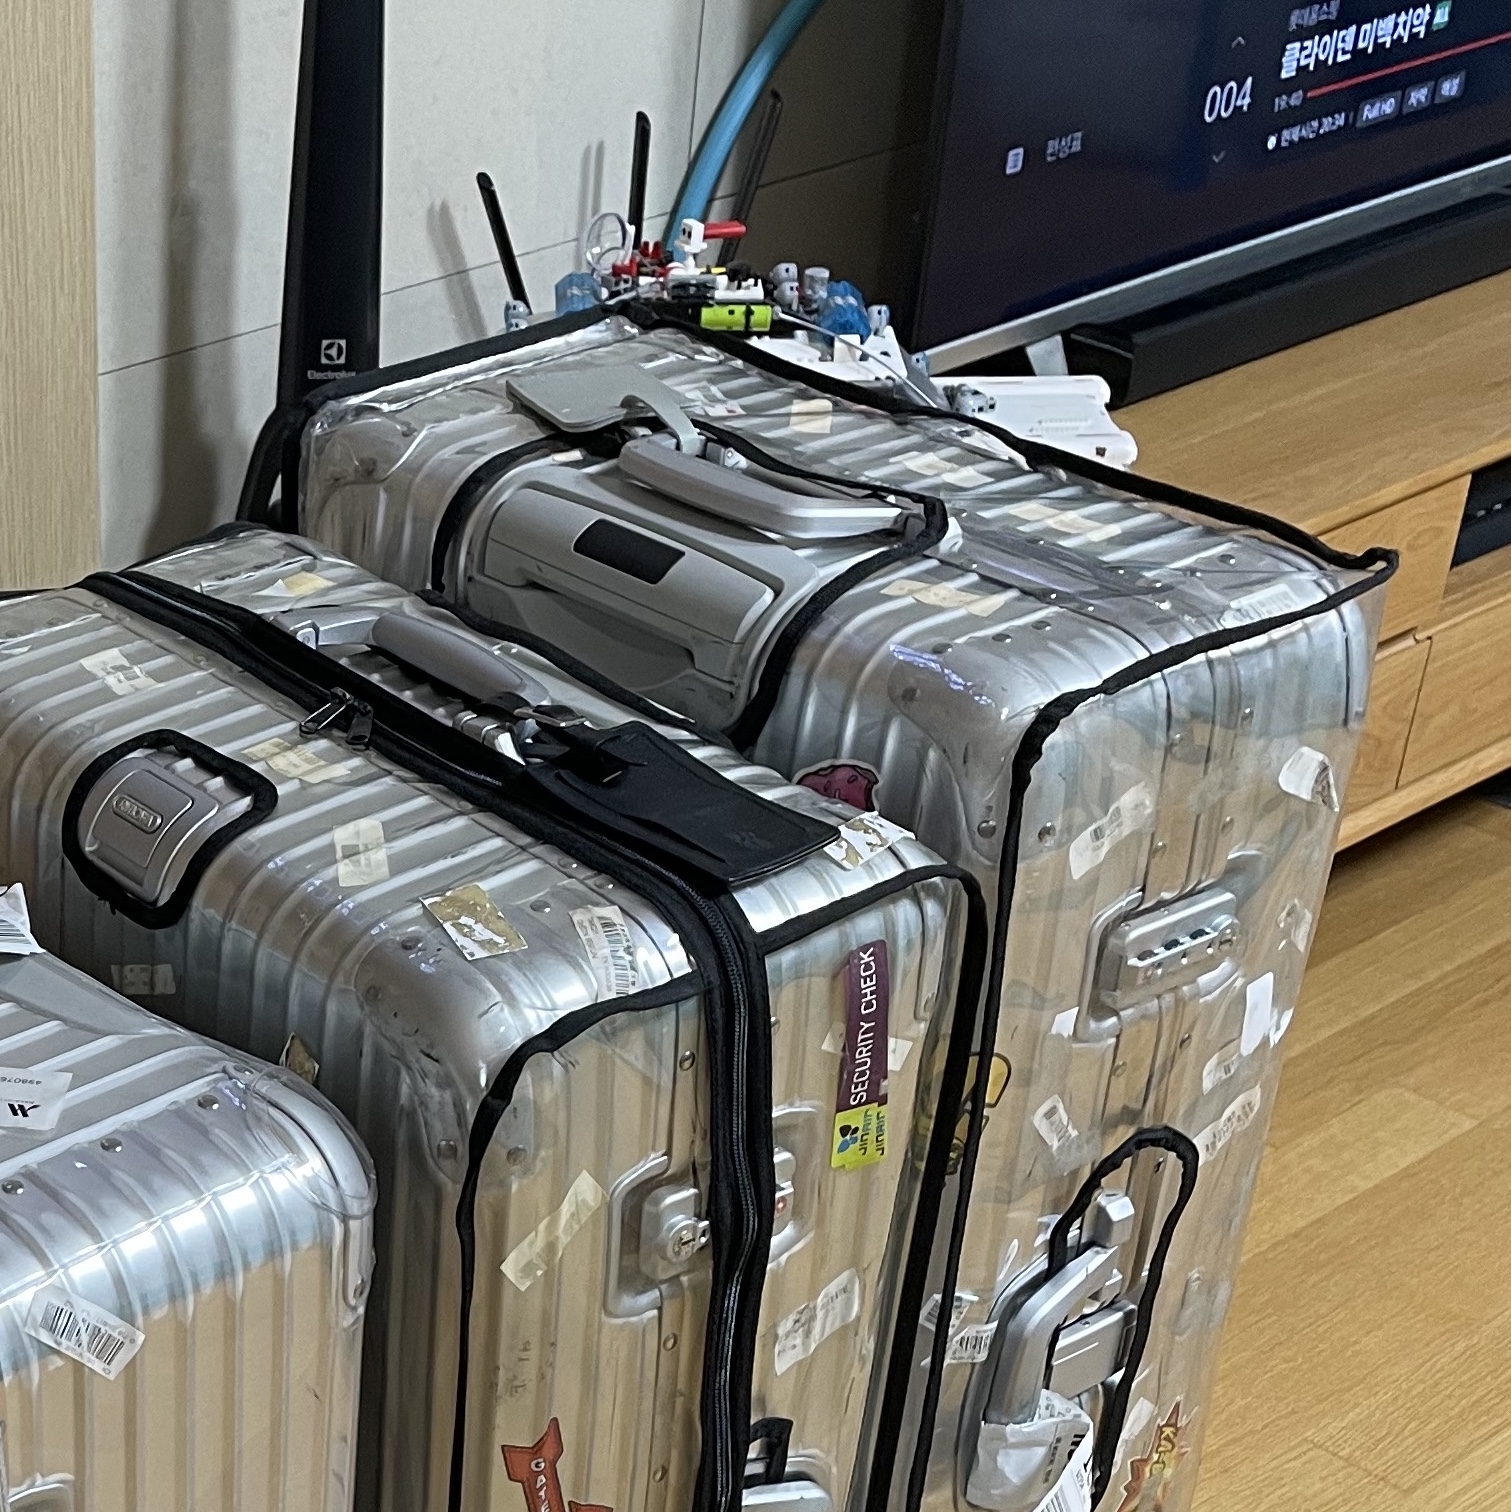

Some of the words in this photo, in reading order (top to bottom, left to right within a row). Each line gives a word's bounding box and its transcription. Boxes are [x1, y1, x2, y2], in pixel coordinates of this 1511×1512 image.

[1280, 24, 1357, 79] 클라이덴
[1357, 3, 1432, 54] 미백치약
[1204, 76, 1253, 123] 004
[859, 946, 877, 1015] CHECK
[850, 1021, 875, 1106] SECURITY
